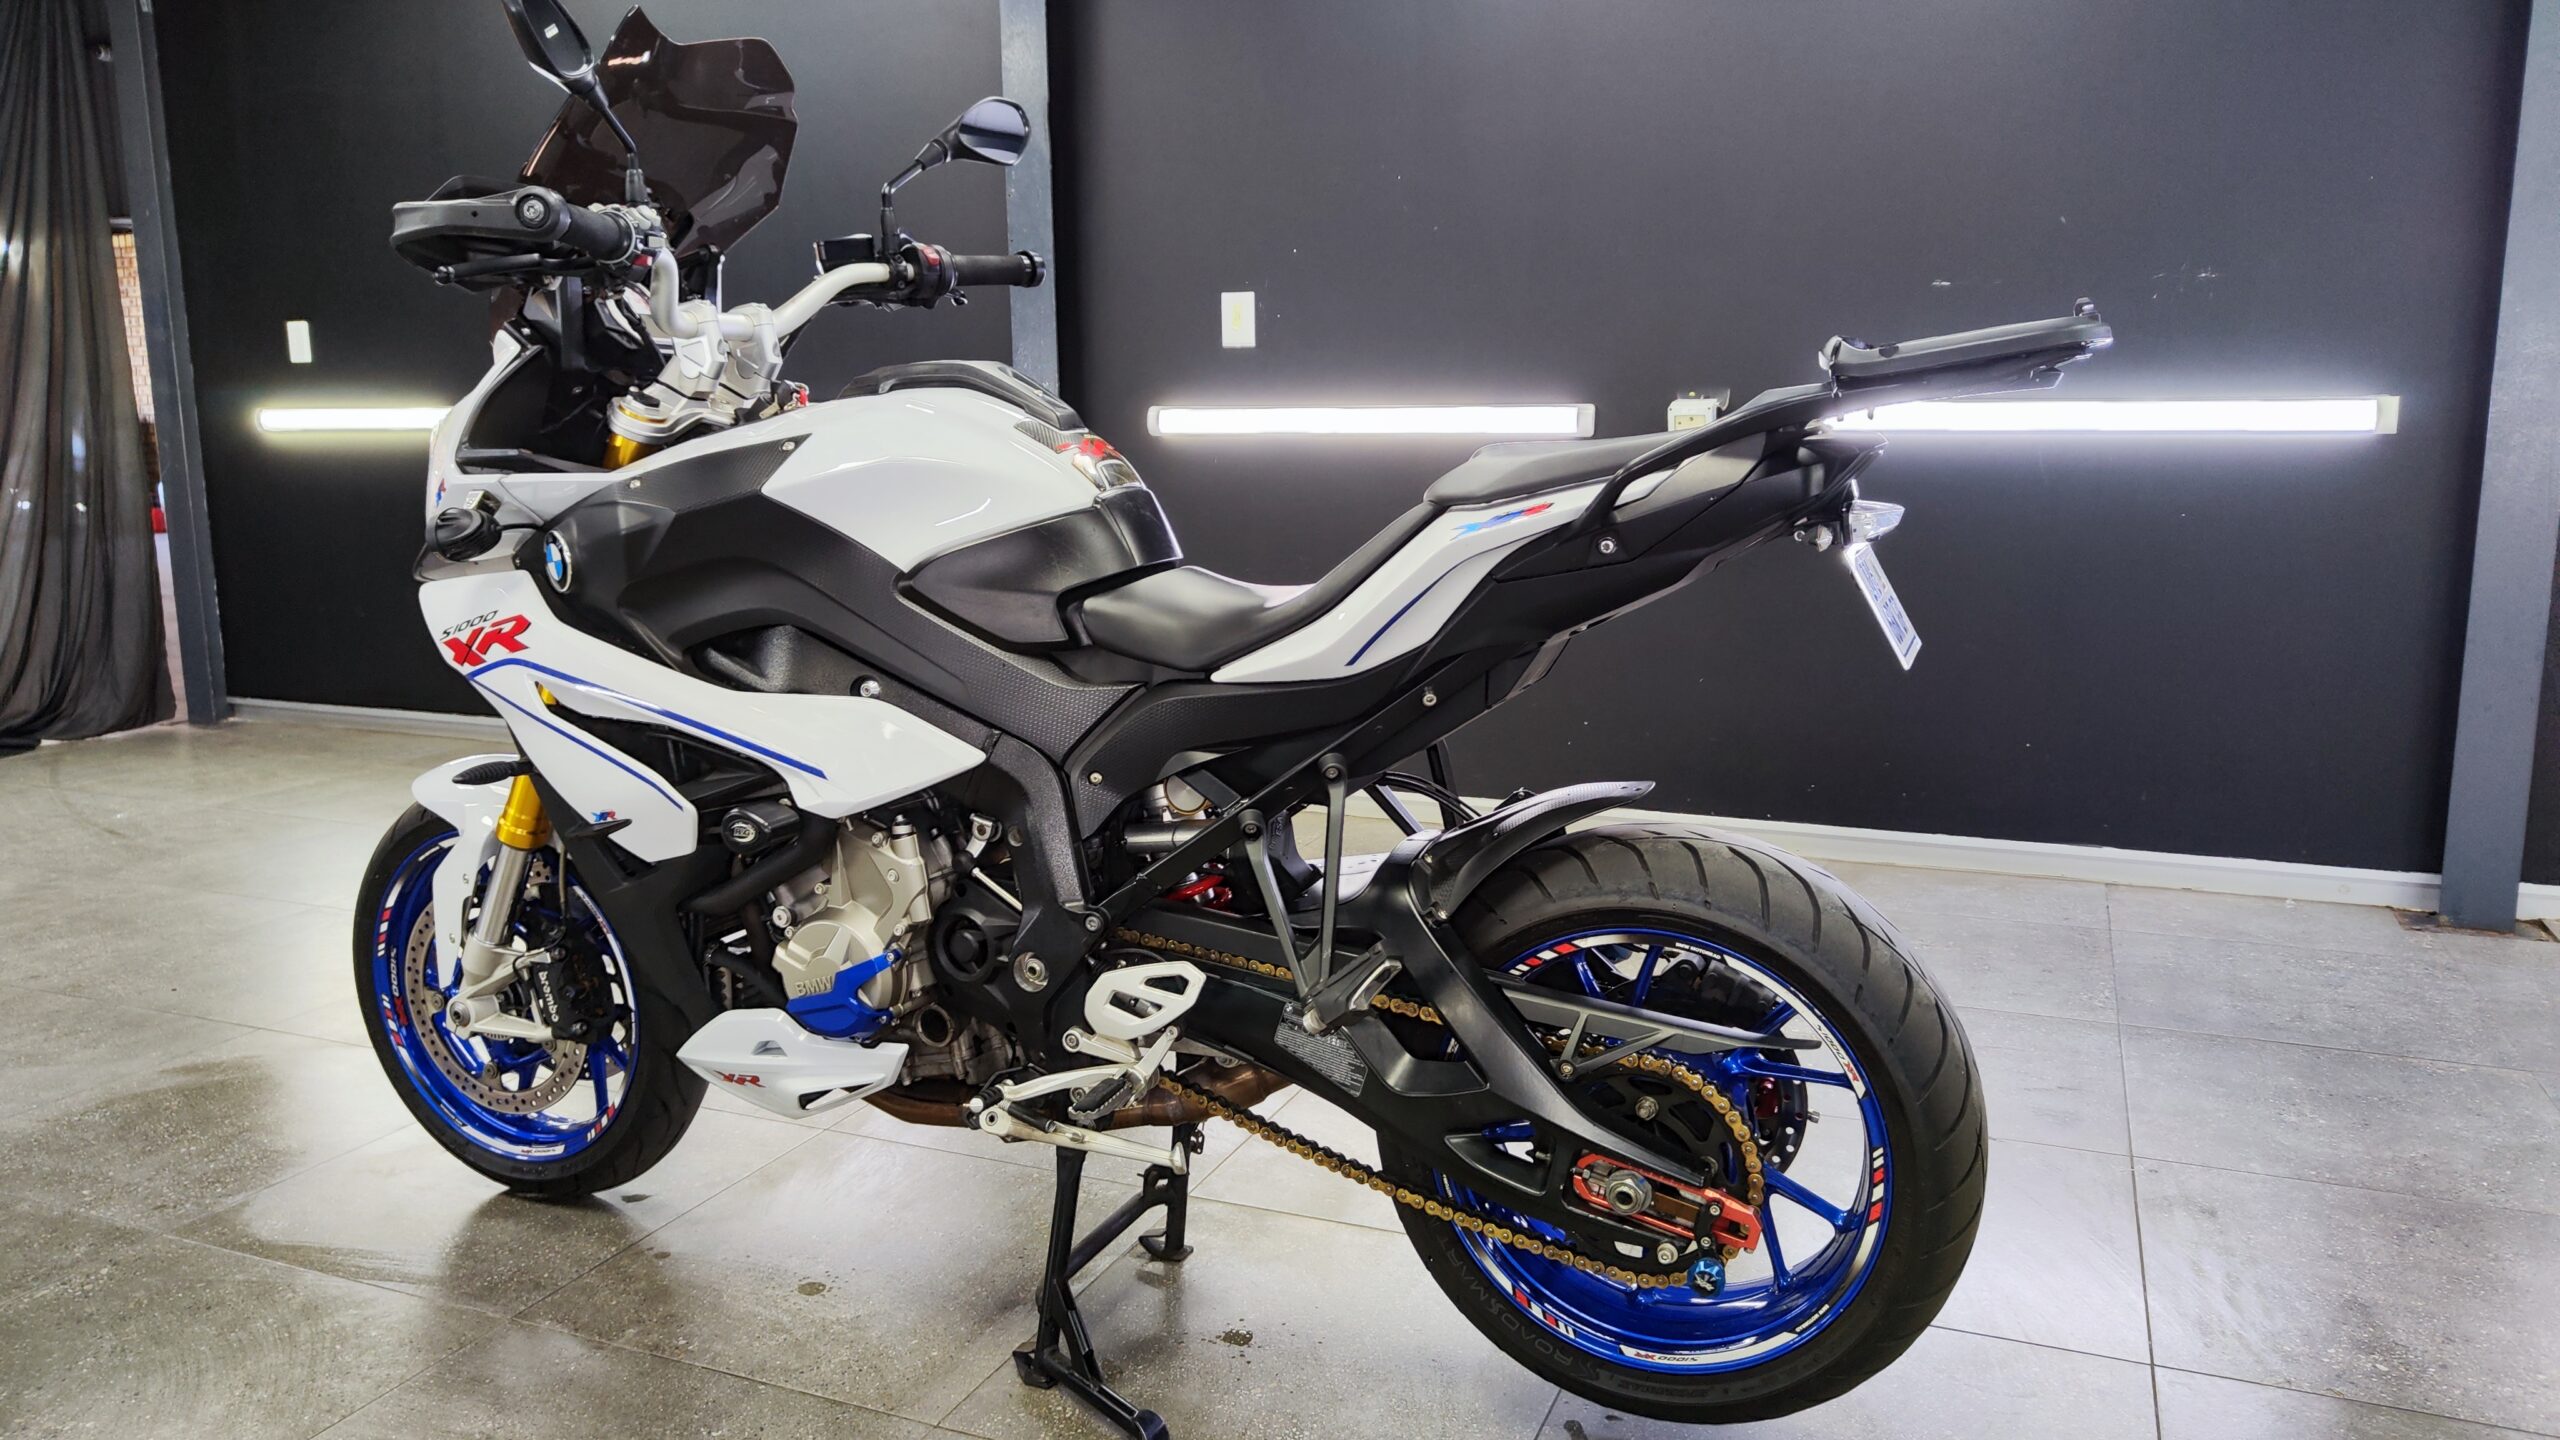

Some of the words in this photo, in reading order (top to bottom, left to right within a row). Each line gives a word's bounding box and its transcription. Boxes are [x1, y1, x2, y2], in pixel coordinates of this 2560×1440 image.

[439, 609, 499, 641] S1000
[442, 614, 532, 667] XR
[538, 970, 559, 1022] brembo
[795, 975, 833, 997] BMW
